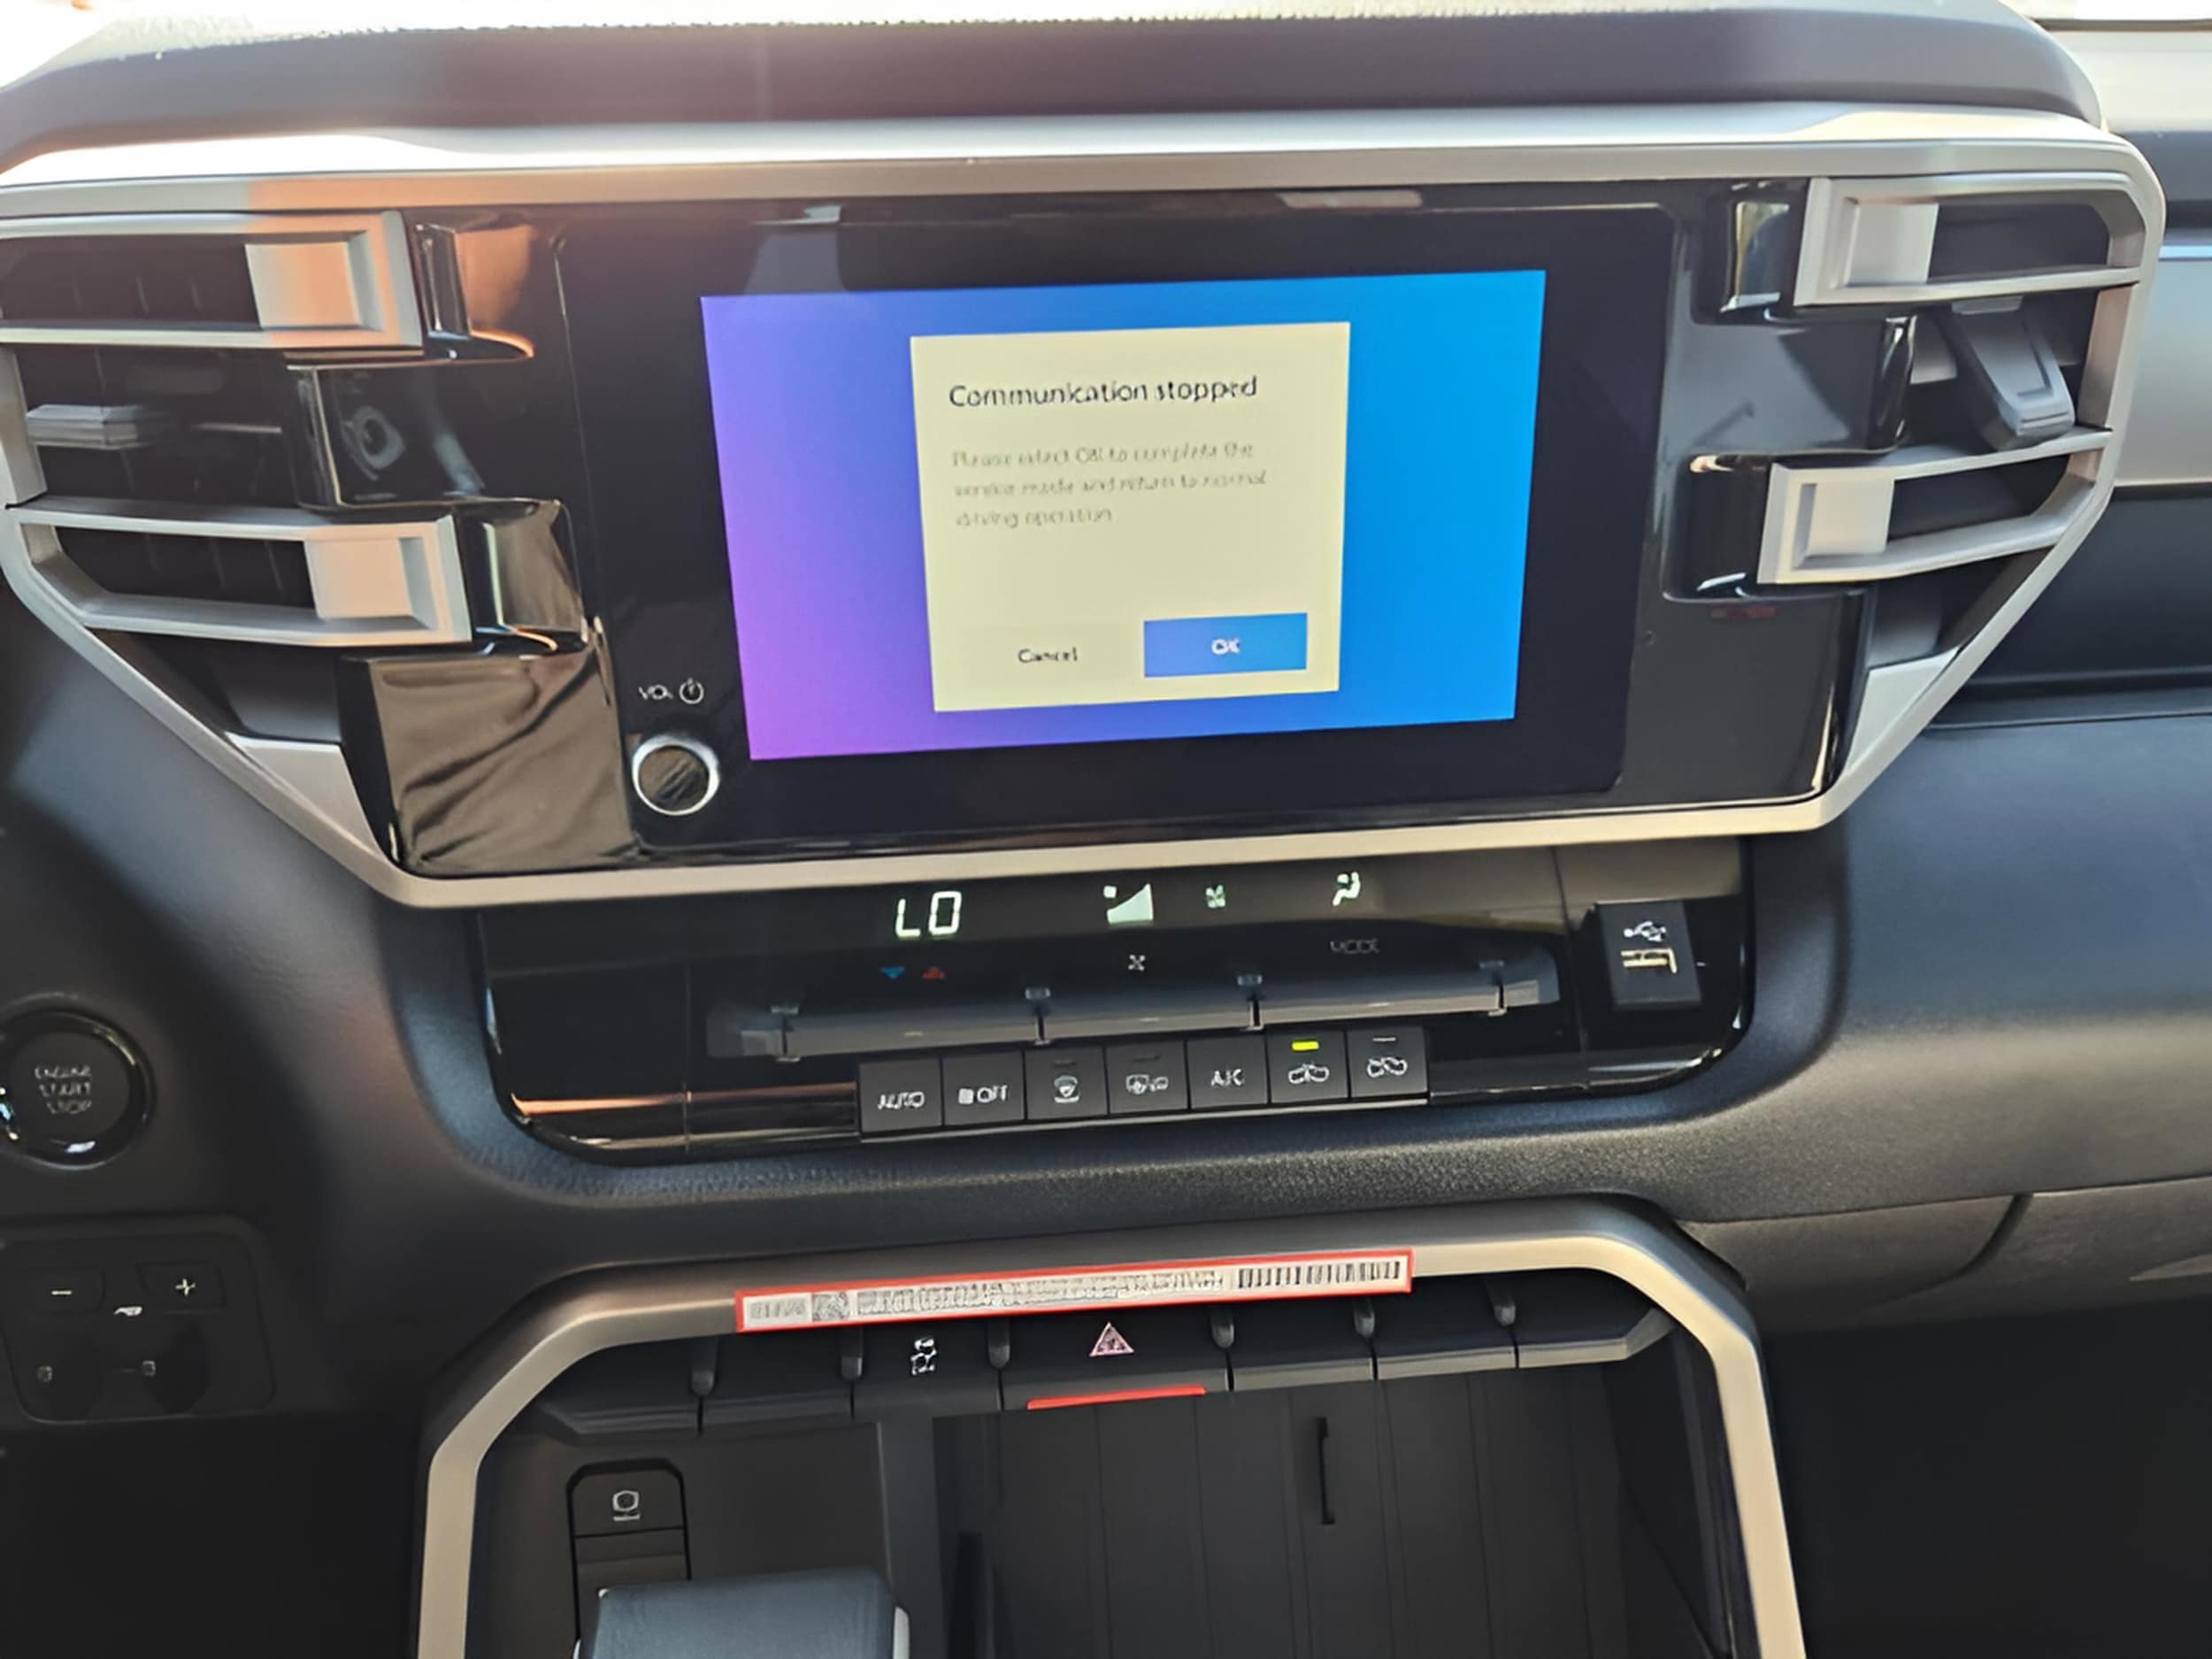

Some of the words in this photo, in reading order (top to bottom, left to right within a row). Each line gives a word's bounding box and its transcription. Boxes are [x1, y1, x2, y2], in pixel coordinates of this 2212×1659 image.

[949, 380, 1148, 408] Communication
[1156, 374, 1258, 403] stopped
[1018, 647, 1079, 664] Cancel
